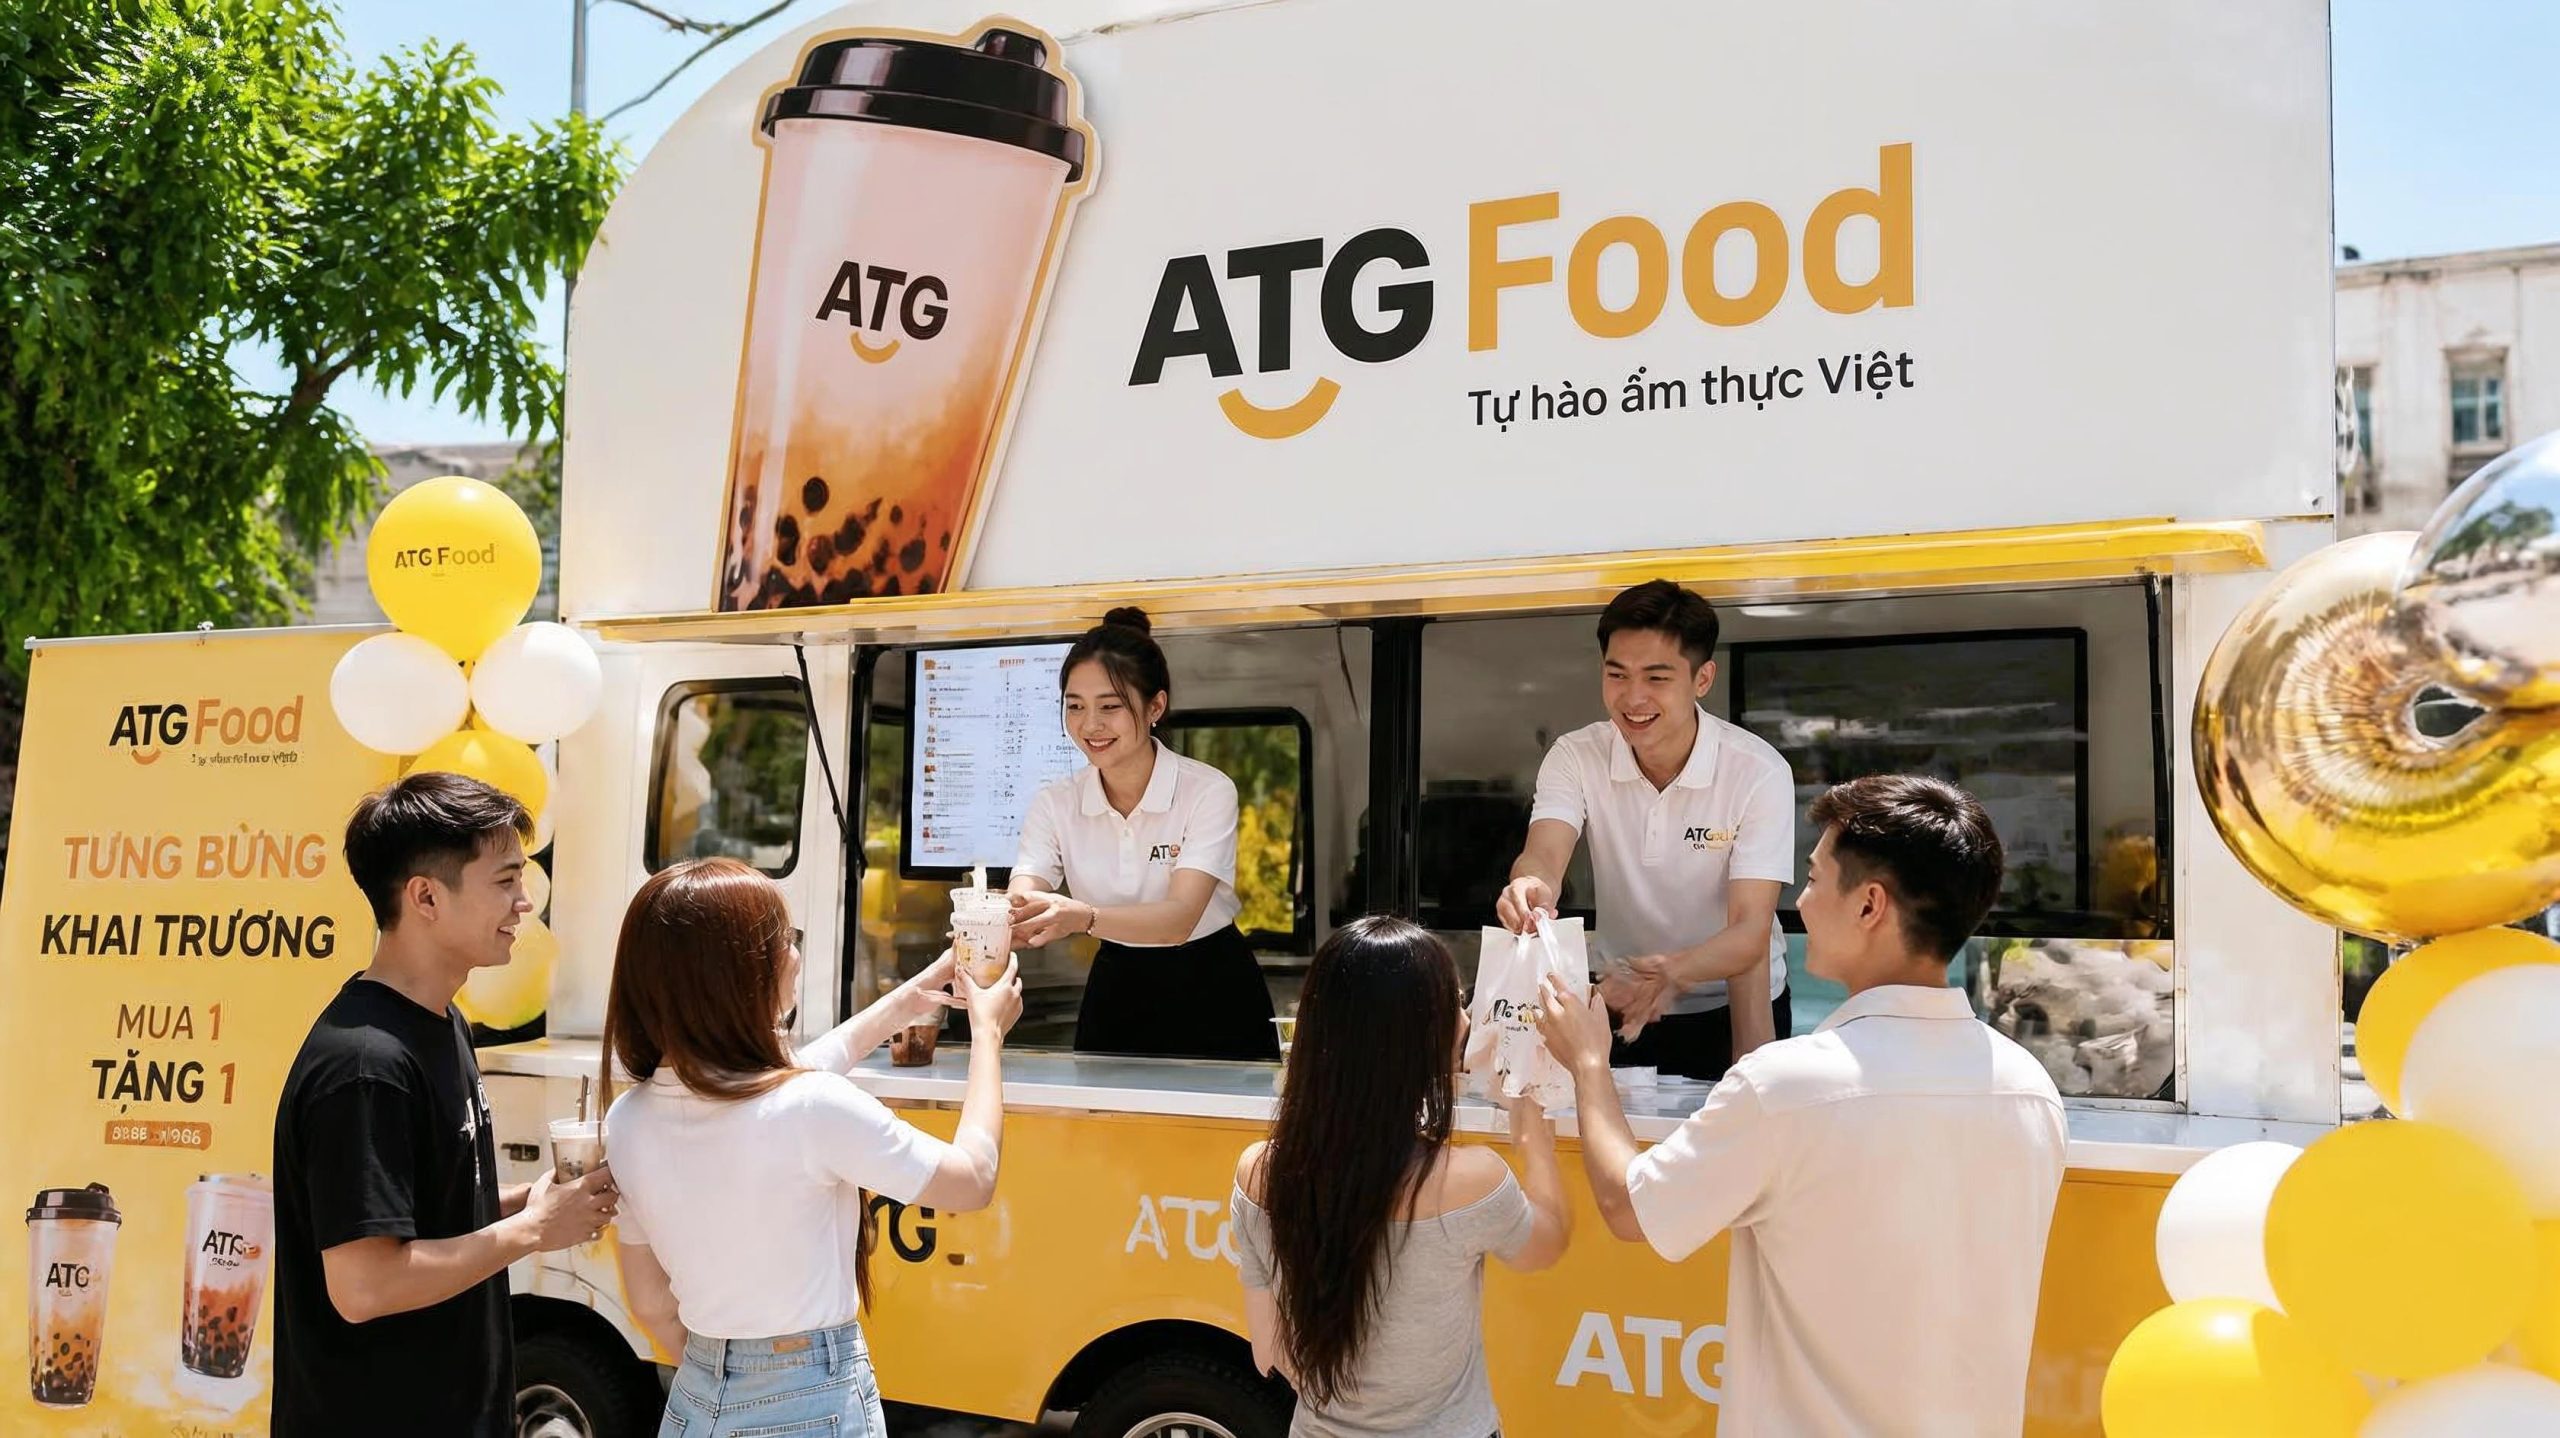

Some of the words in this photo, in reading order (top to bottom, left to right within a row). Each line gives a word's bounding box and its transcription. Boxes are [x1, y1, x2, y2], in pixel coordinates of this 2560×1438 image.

[1128, 227, 1433, 386] ATG
[1468, 142, 1915, 352] Food
[814, 260, 949, 341] ATG
[1468, 389, 1520, 432] Tự
[1532, 380, 1607, 420] hào
[1621, 366, 1686, 413] ẩm
[1701, 365, 1804, 411] thực
[1817, 350, 1914, 400] Việt
[395, 548, 432, 568] ATG
[437, 543, 495, 566] Food
[109, 704, 188, 746] ATG
[194, 695, 303, 745] Food
[41, 914, 142, 955] KHAI
[154, 908, 335, 959] TRƯƠNG
[117, 1003, 194, 1040] MUA
[209, 1002, 221, 1040] 1
[92, 1049, 205, 1113] TẶNG
[220, 1062, 235, 1104] 1
